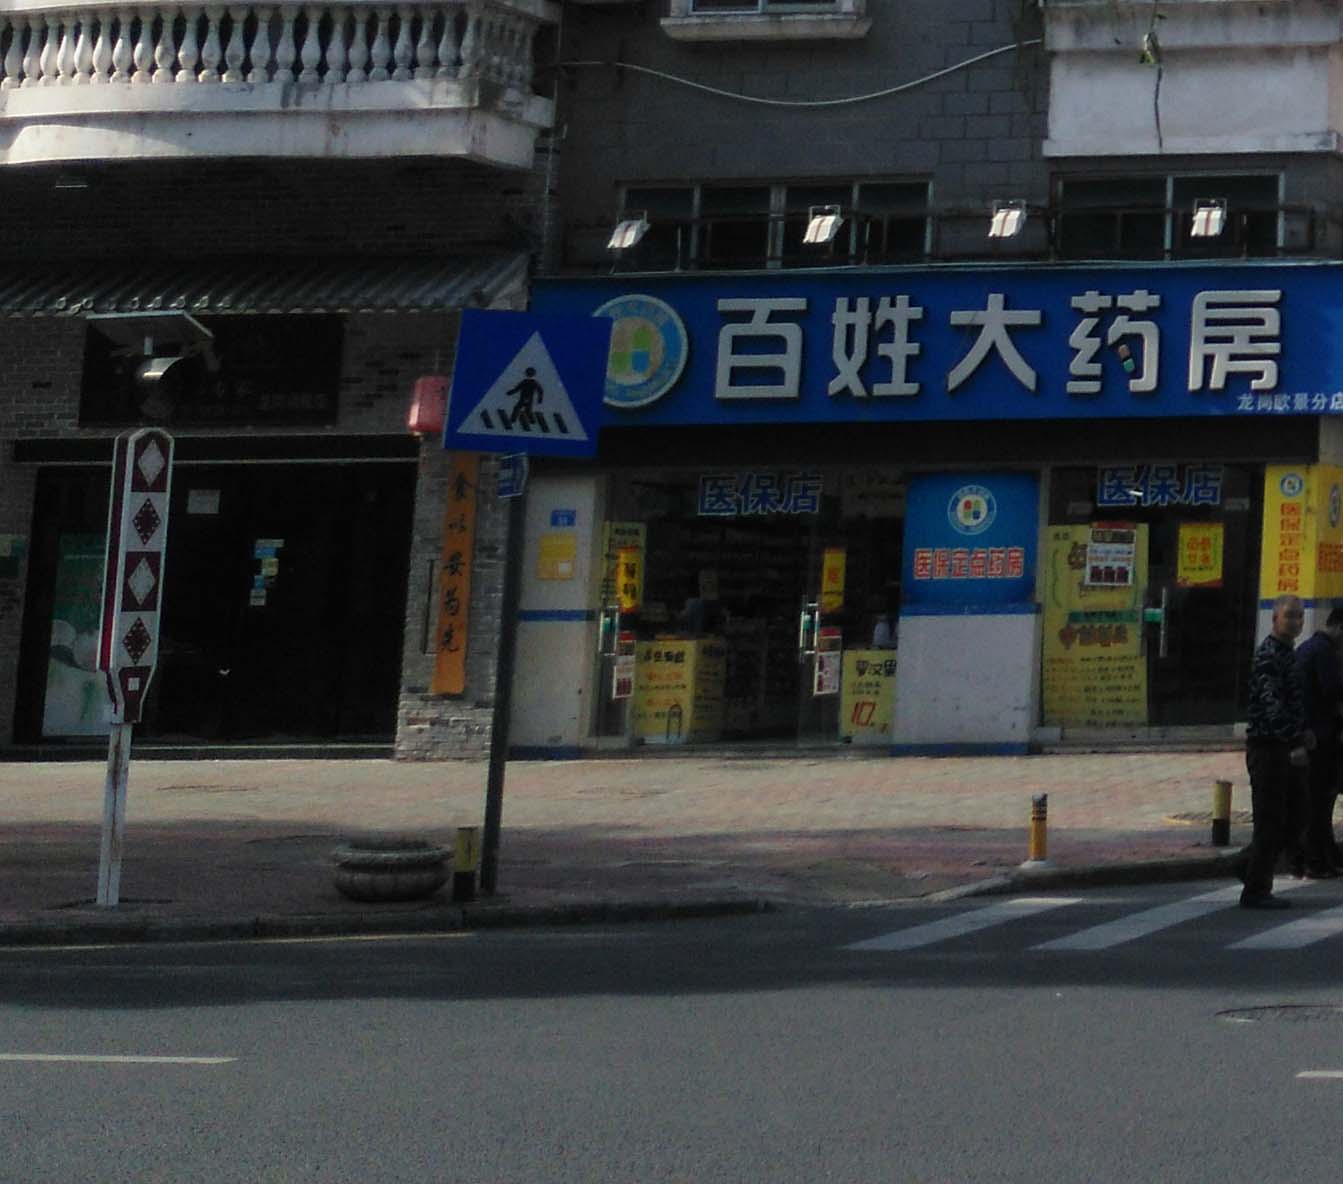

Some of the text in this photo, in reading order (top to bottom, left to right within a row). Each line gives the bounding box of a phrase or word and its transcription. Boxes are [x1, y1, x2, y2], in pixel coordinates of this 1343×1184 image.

[714, 289, 1283, 400] 百姓大药房
[697, 472, 824, 516] 医保店
[1097, 464, 1223, 507] 医保店
